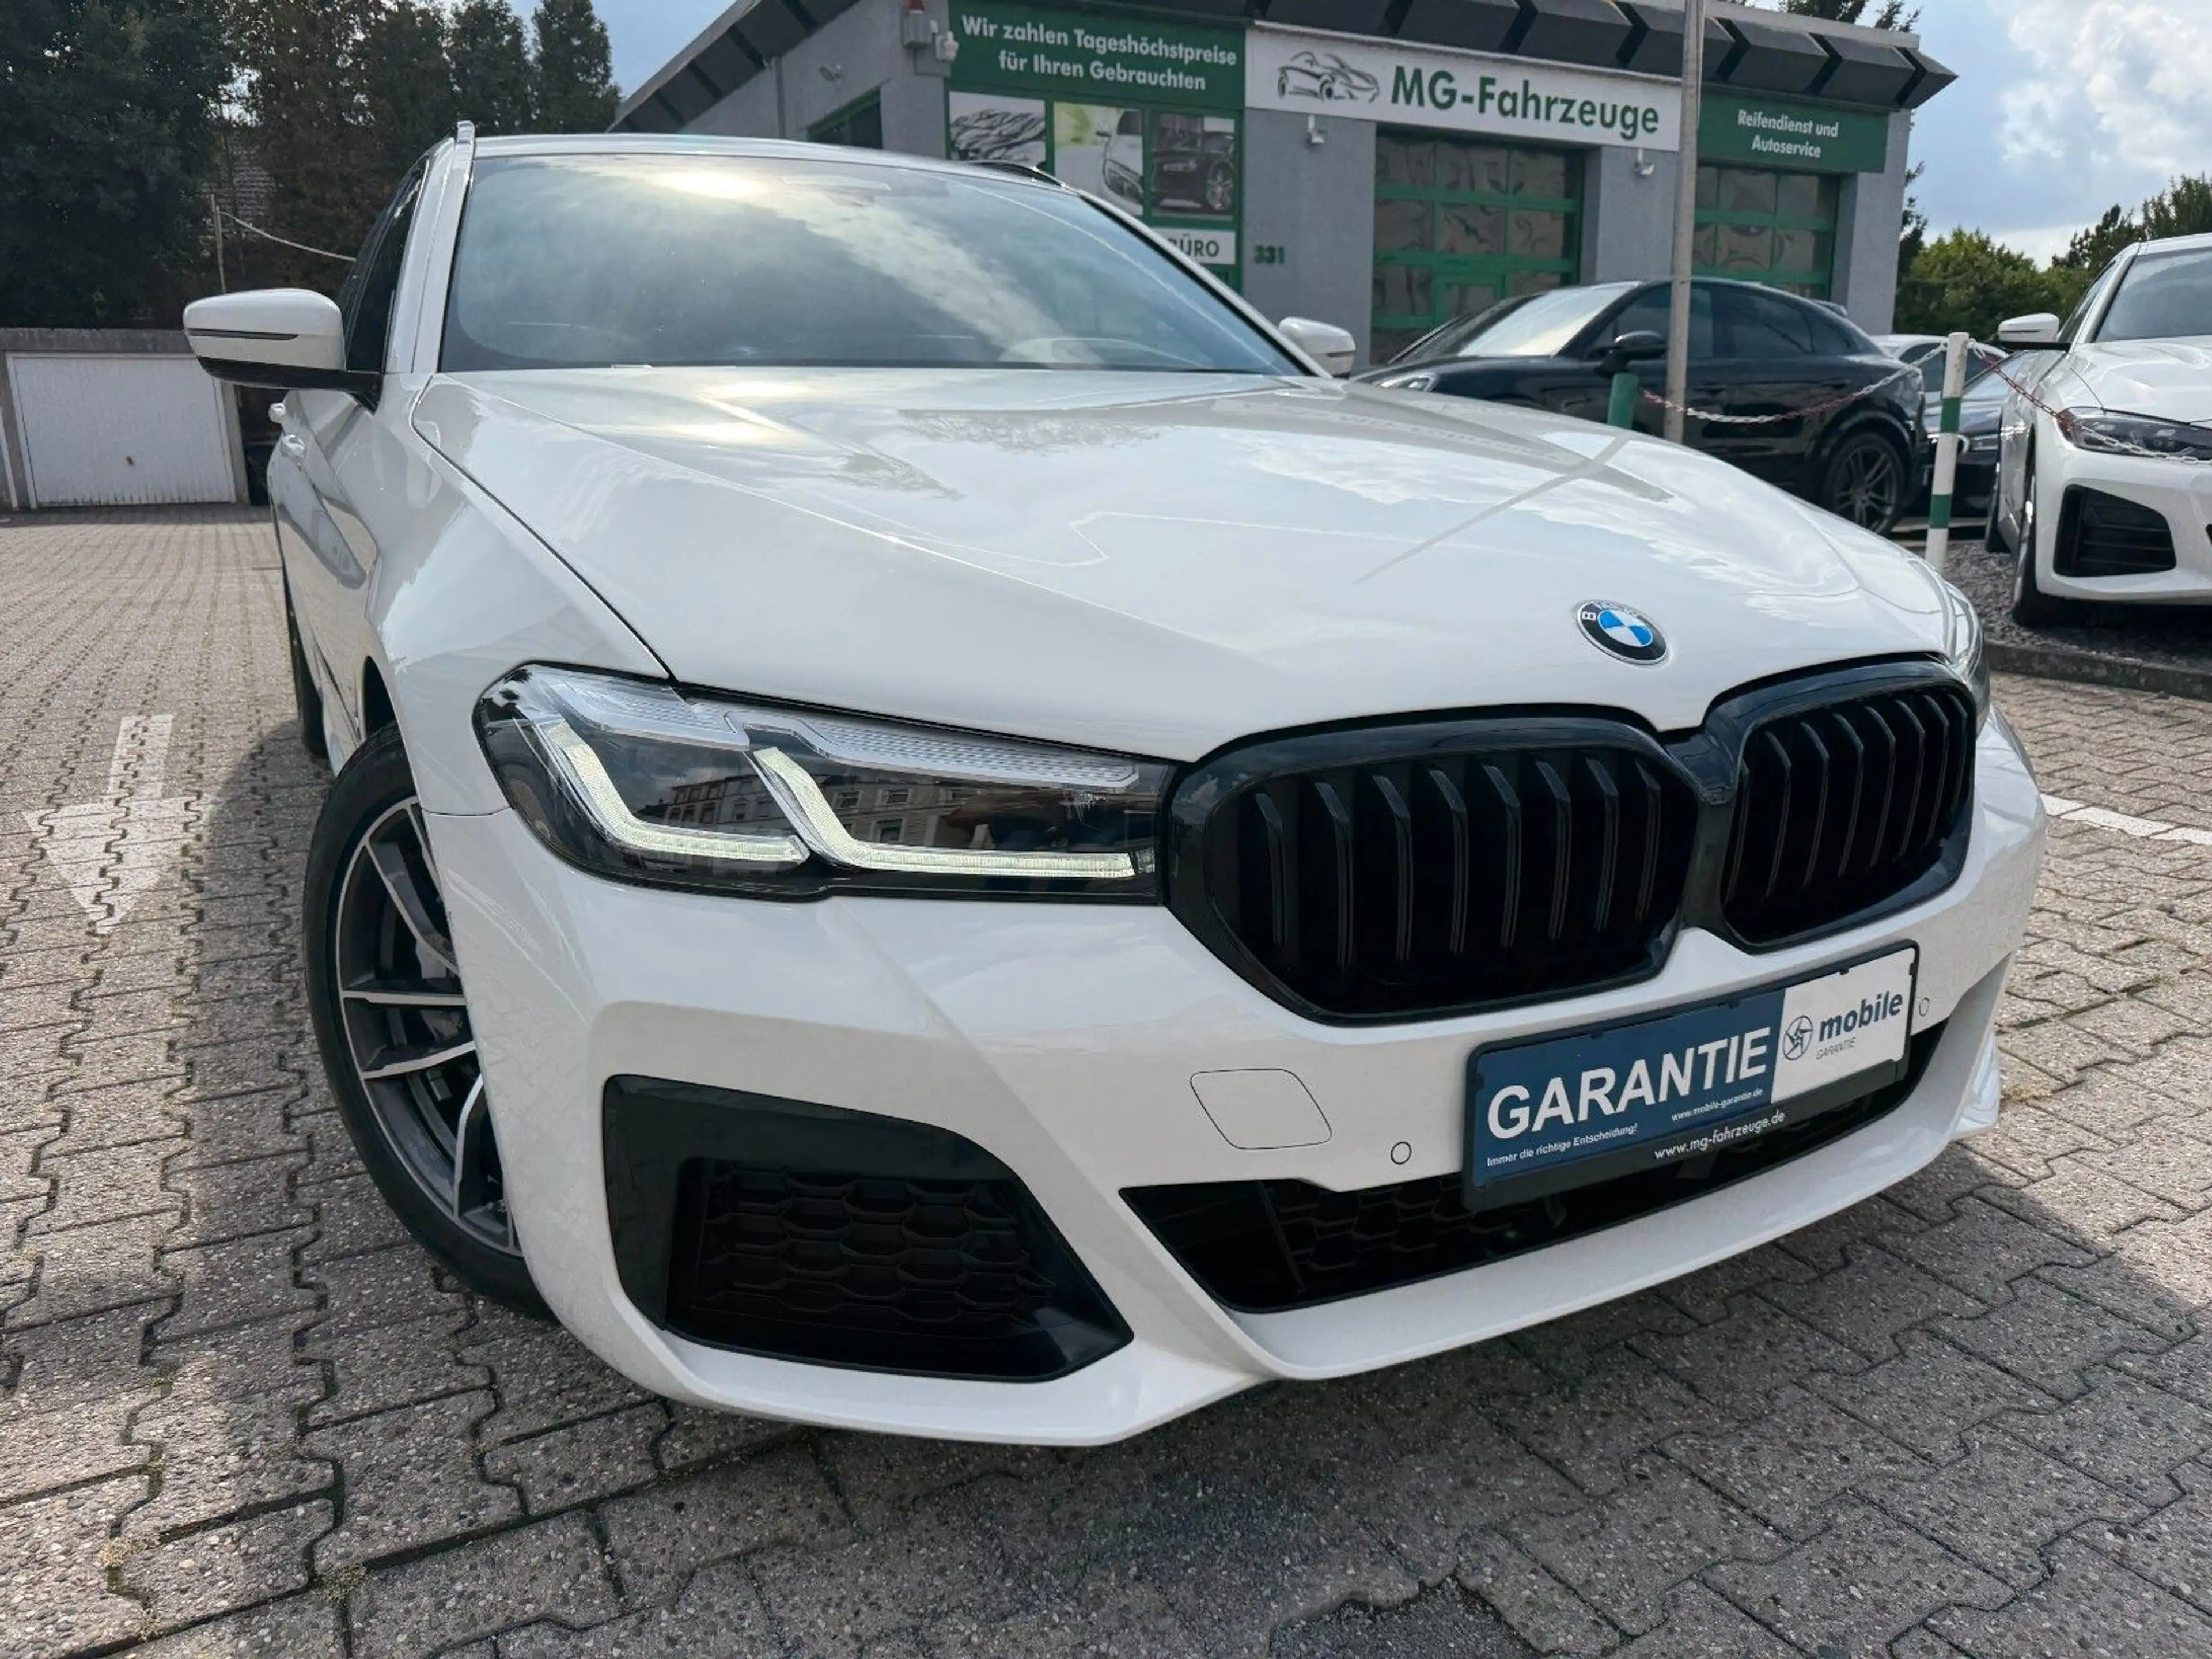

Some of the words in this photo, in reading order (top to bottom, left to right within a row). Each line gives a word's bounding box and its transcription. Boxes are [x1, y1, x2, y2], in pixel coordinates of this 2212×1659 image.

[961, 14, 998, 37] Wir
[1003, 21, 1069, 46] zahlen
[1073, 29, 1237, 66] Tageshöchstpreise
[998, 50, 1028, 71] für
[1032, 54, 1084, 78] Ihren
[1089, 60, 1206, 90] Gebrauchten
[1391, 65, 1659, 141] MG-Fahrzeuge
[1737, 109, 1813, 134] Reifendienst
[1816, 122, 1839, 138] und
[1751, 134, 1821, 158] Autoservice
[1253, 245, 1285, 264] 331
[1818, 990, 1903, 1042] mobile
[1816, 1036, 1857, 1060] GARANTIE
[1487, 1027, 1771, 1139] GARANTIE
[1671, 1087, 1763, 1122] www.mobile-garantie.de
[1487, 1152, 1518, 1167] Immer
[1519, 1148, 1535, 1160] die
[1536, 1139, 1571, 1156] richtige
[1573, 1123, 1638, 1147] Entscheidung!
[1654, 1109, 1785, 1160] www.mg-fahrzeuge.de
